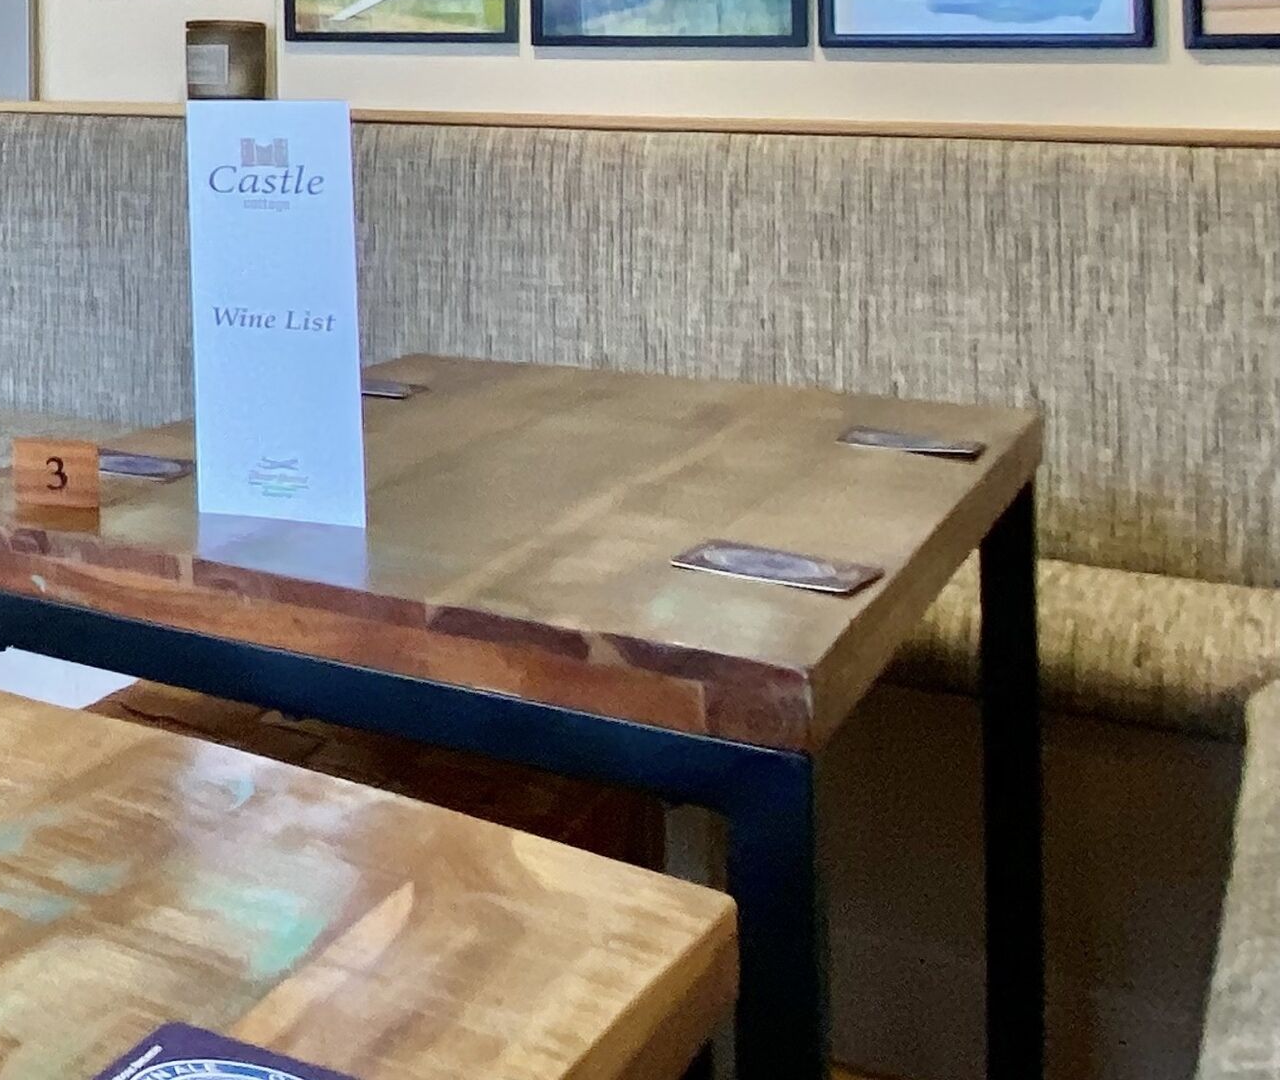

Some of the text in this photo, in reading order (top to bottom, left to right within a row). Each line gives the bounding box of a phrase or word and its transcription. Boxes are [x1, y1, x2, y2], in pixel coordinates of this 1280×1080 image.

[208, 164, 325, 195] Castle
[212, 306, 336, 333] Wine List
[45, 455, 69, 491] 3
